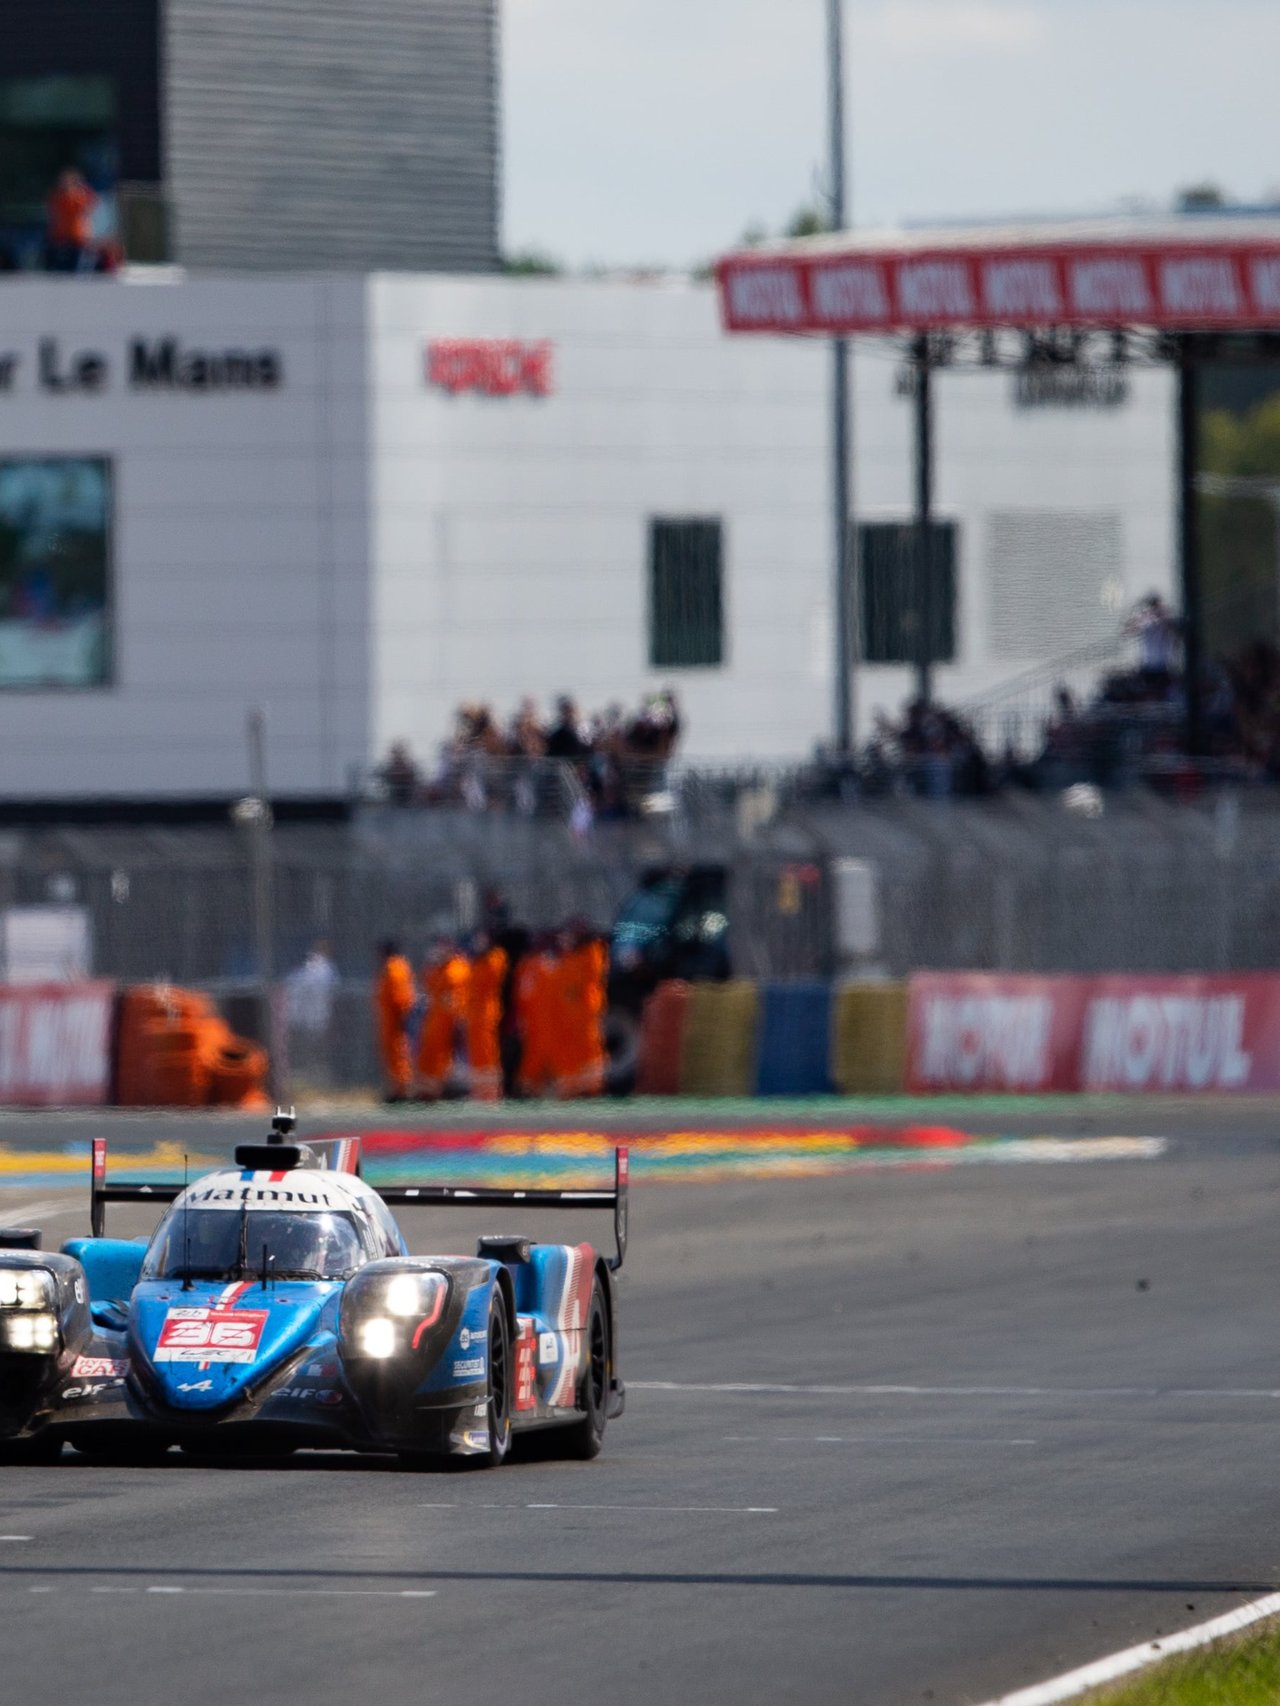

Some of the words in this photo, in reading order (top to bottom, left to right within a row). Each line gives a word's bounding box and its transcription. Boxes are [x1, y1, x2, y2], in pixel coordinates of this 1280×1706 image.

[37, 335, 110, 395] Le
[128, 334, 284, 392] Mans
[184, 1187, 332, 1207] Matmut
[163, 1321, 257, 1346] 36
[62, 1383, 108, 1399] elf
